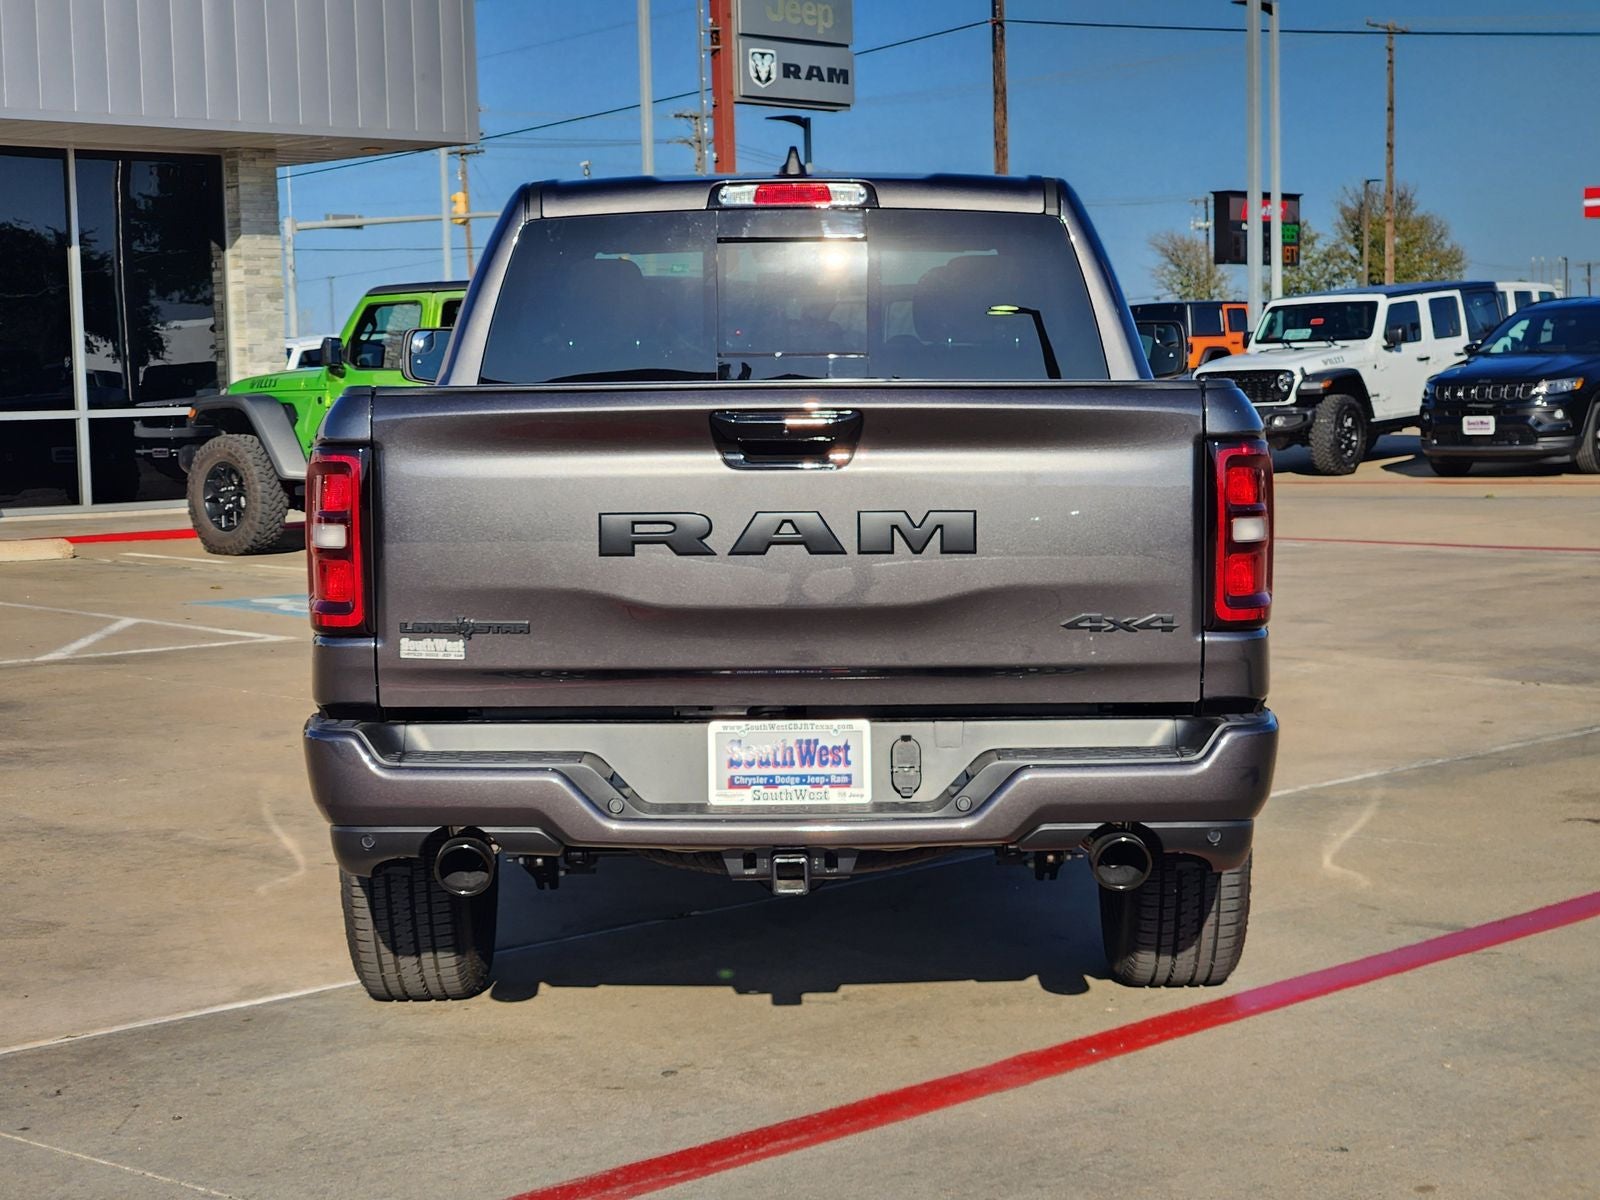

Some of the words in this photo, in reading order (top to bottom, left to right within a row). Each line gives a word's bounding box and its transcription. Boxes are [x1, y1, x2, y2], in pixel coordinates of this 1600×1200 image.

[766, 0, 833, 34] Jeep
[782, 62, 849, 85] RAM
[598, 510, 977, 557] RAM
[474, 621, 530, 634] STAR
[1060, 613, 1180, 632] 4x4
[734, 775, 768, 786] Chrysler
[775, 774, 801, 785] Dodge
[806, 775, 825, 785] Jeep
[830, 774, 849, 784] Ram
[752, 788, 830, 801] SouthWest
